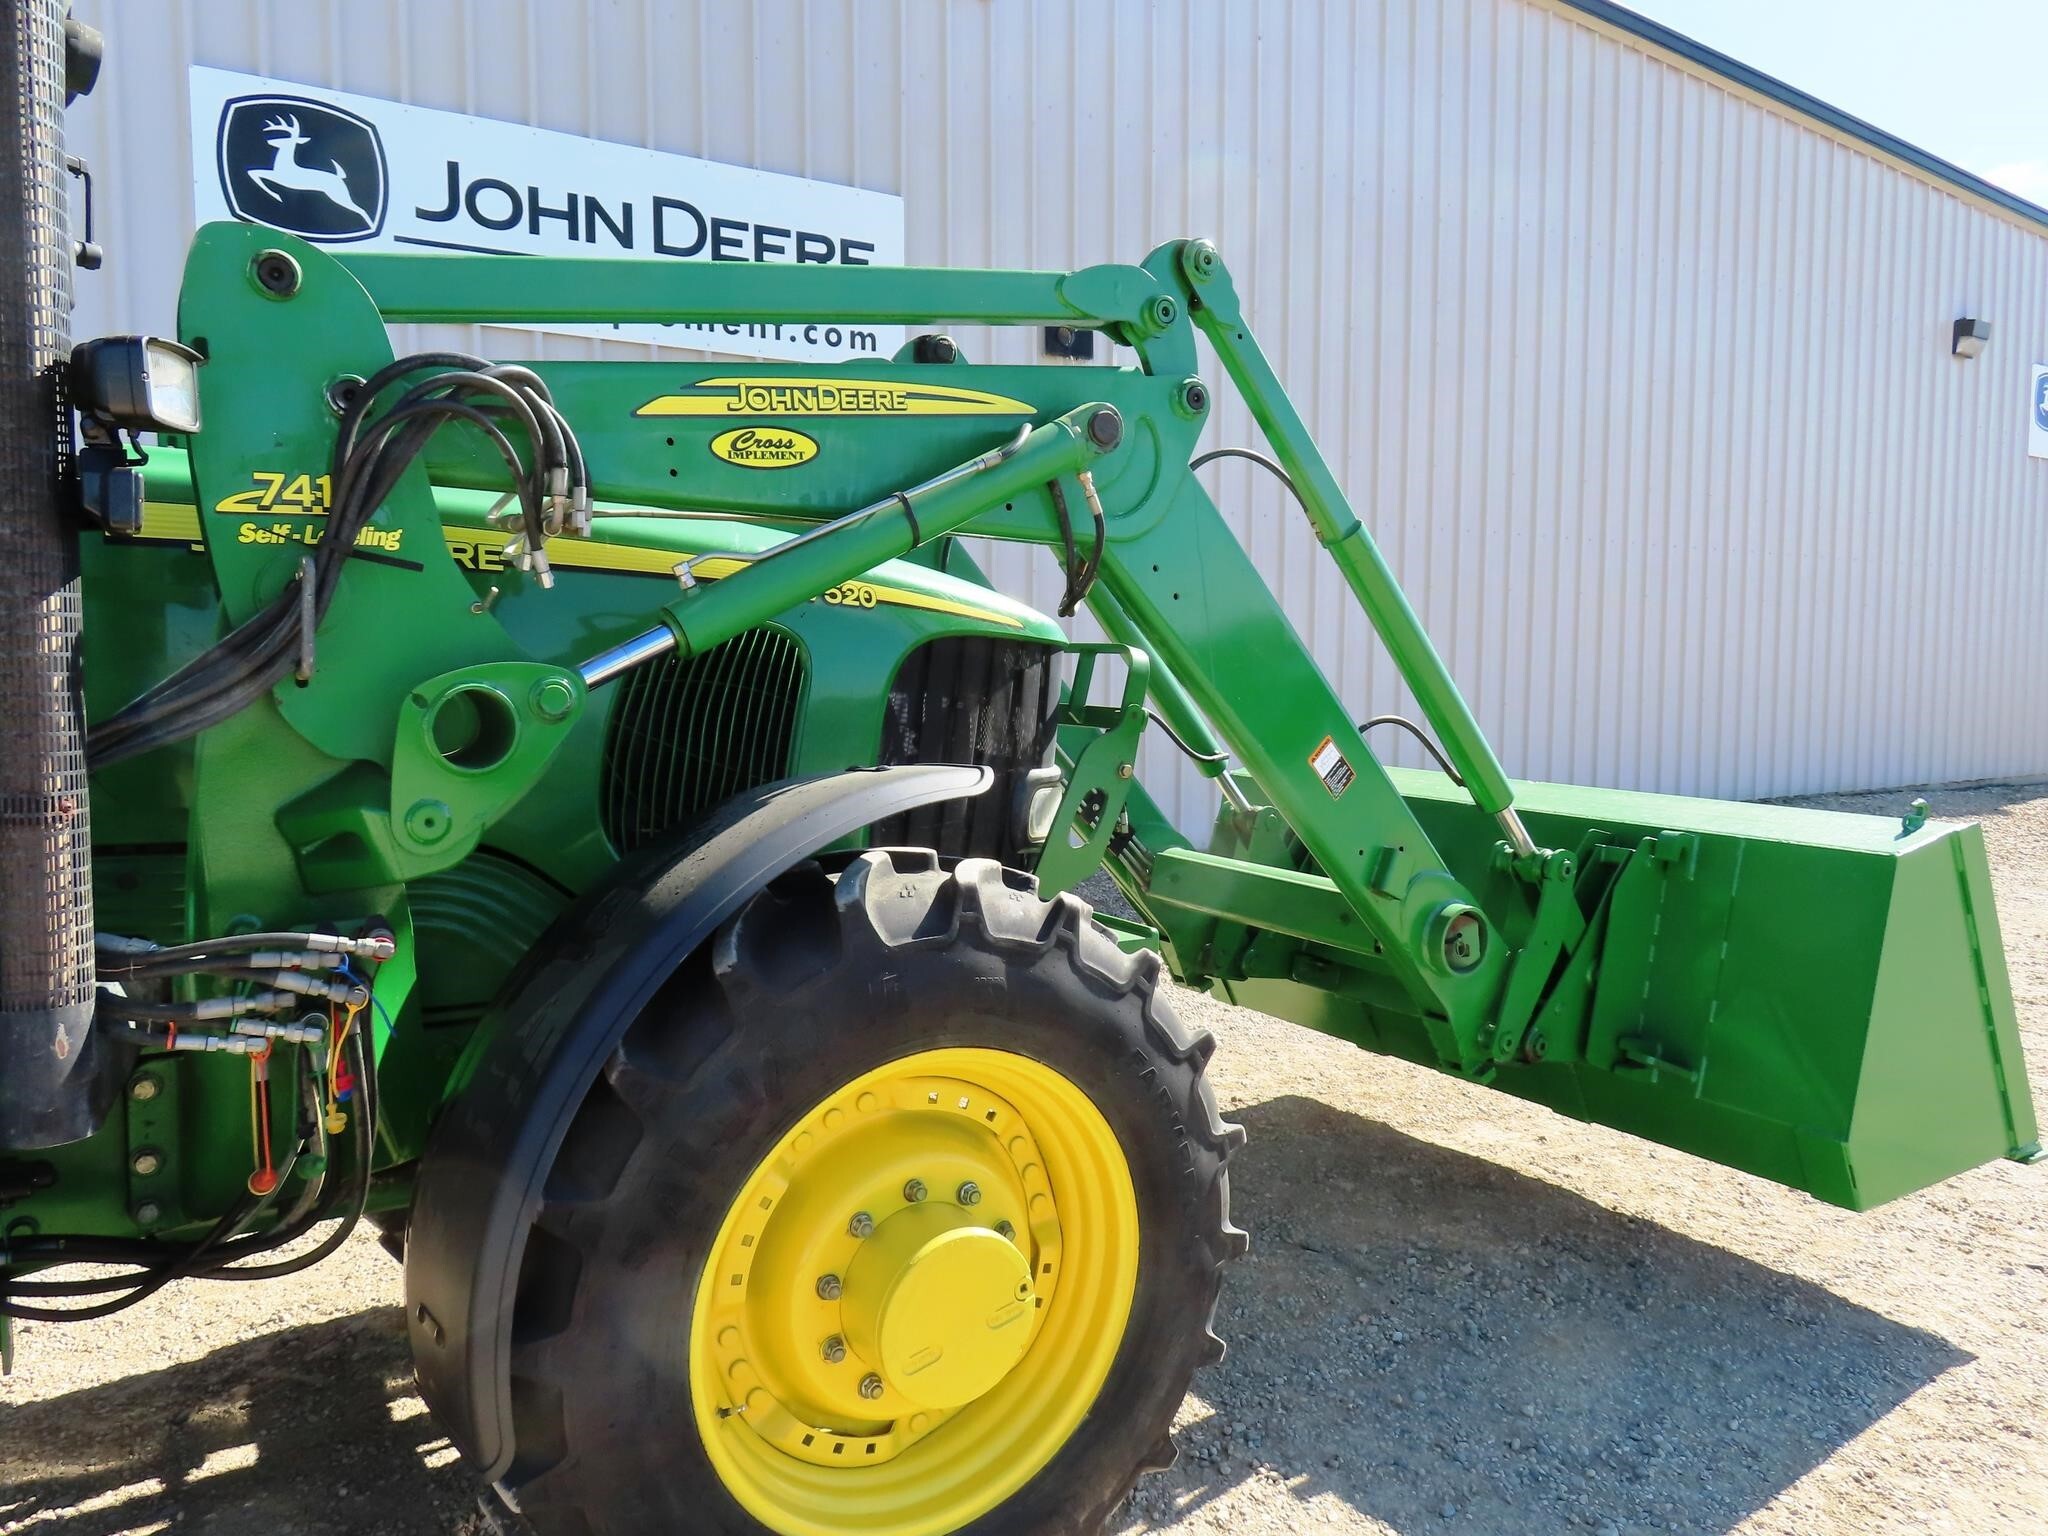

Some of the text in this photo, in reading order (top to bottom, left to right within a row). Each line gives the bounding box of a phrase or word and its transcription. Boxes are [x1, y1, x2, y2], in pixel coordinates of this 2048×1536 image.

[415, 159, 875, 265] JOHN DEERE
[728, 383, 908, 411] JOHN DEERE
[729, 430, 796, 452] Cross
[727, 450, 806, 461] IMPLEMENT
[252, 472, 332, 511] 741
[810, 583, 878, 609] 520
